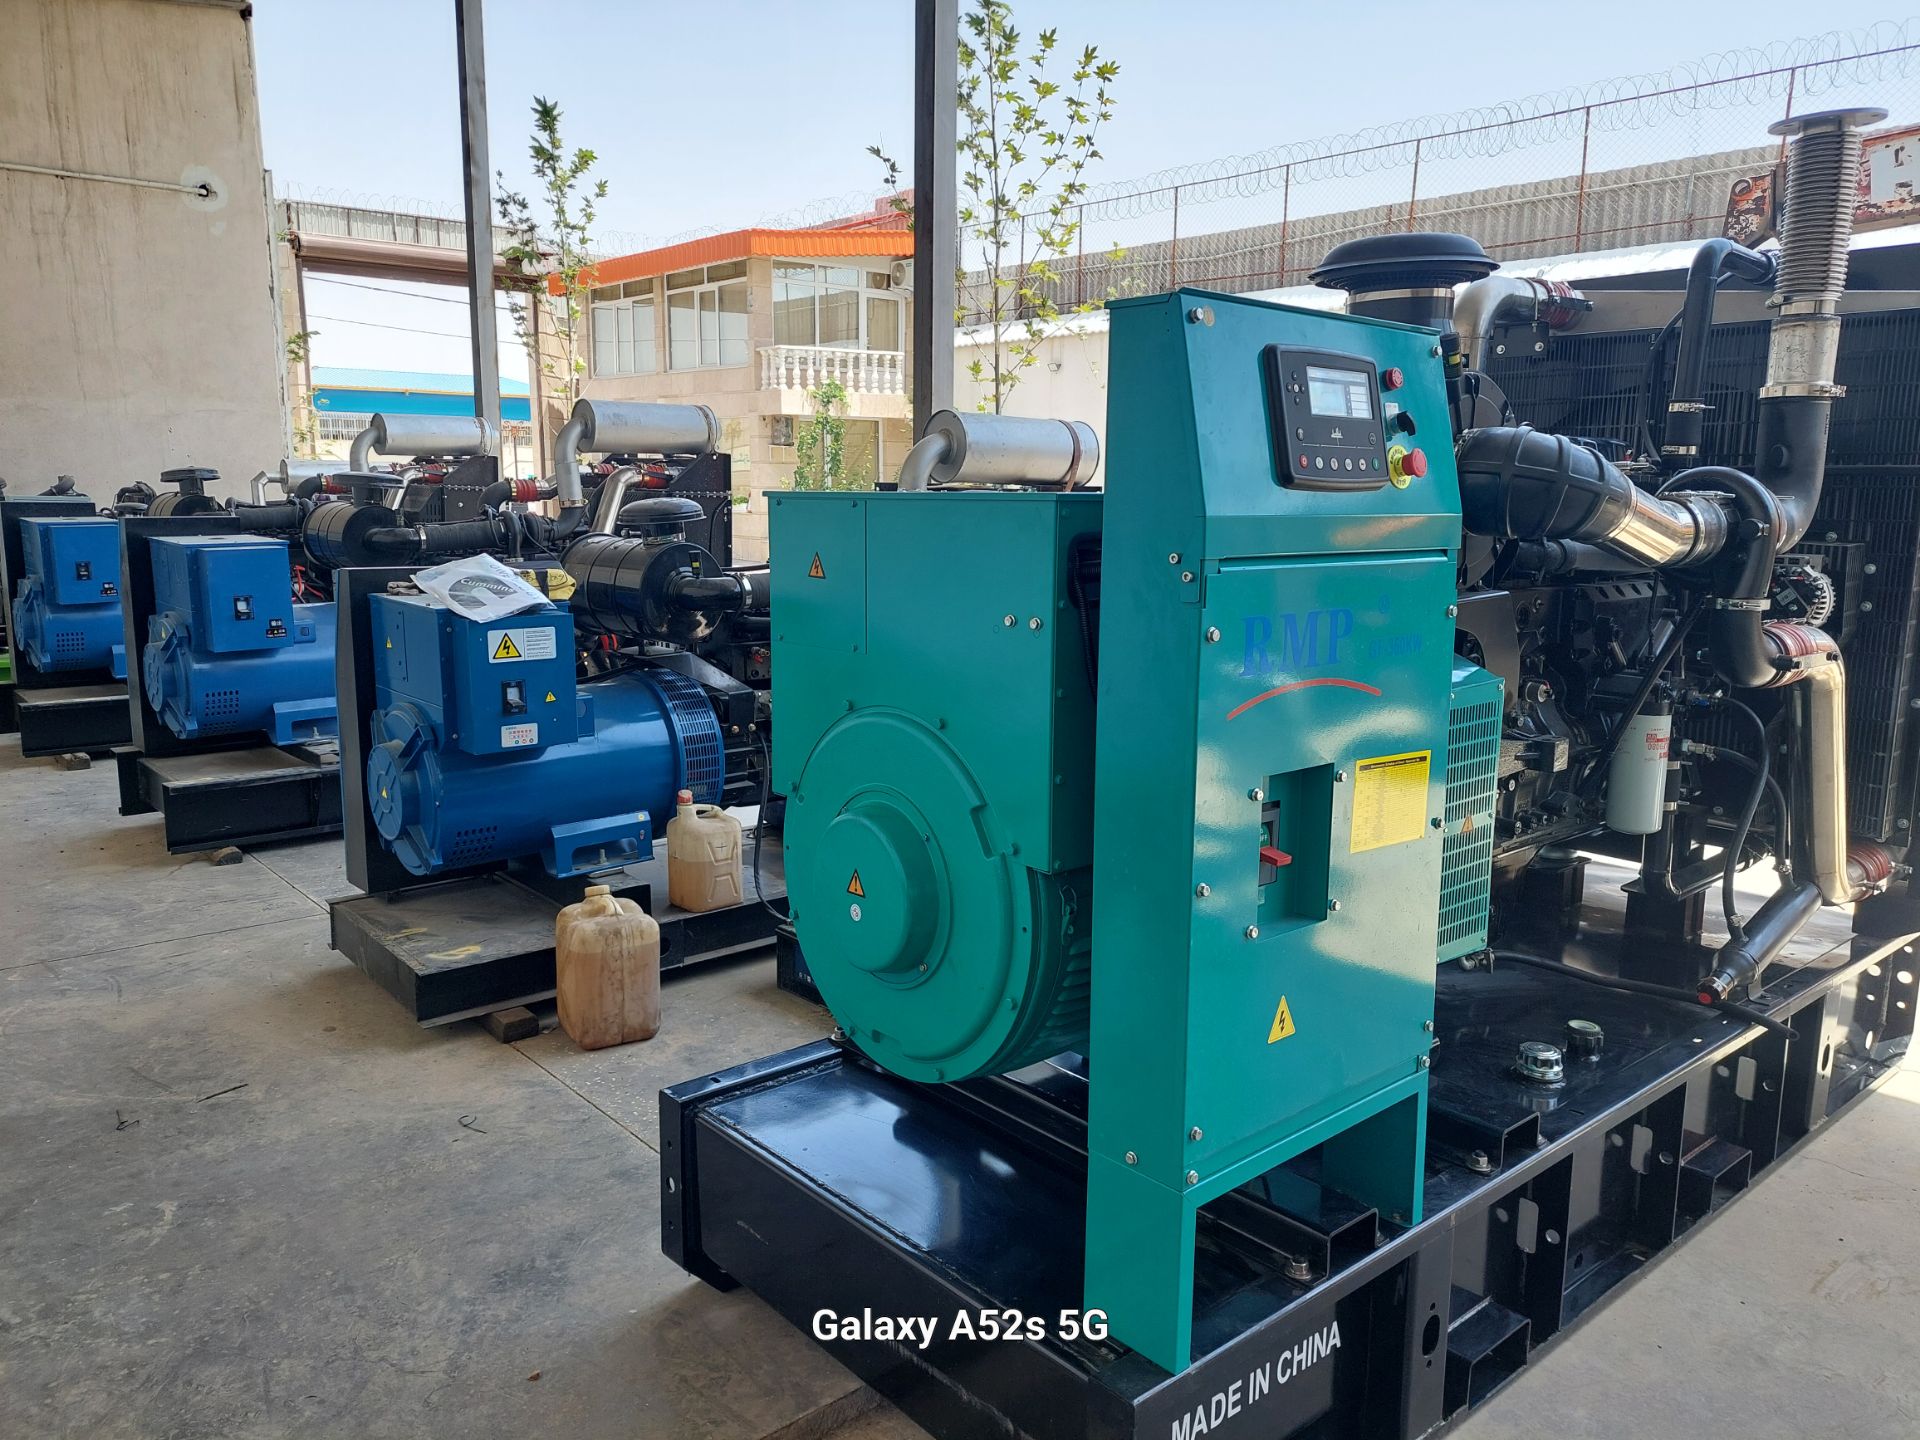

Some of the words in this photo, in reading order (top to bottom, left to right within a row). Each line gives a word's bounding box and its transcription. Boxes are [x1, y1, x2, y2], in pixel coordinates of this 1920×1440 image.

[460, 578, 514, 593] Cummins
[1239, 607, 1354, 677] RMP
[1171, 1379, 1243, 1440] MADE
[1248, 1362, 1271, 1405] IN
[1276, 1320, 1342, 1385] CHINA
